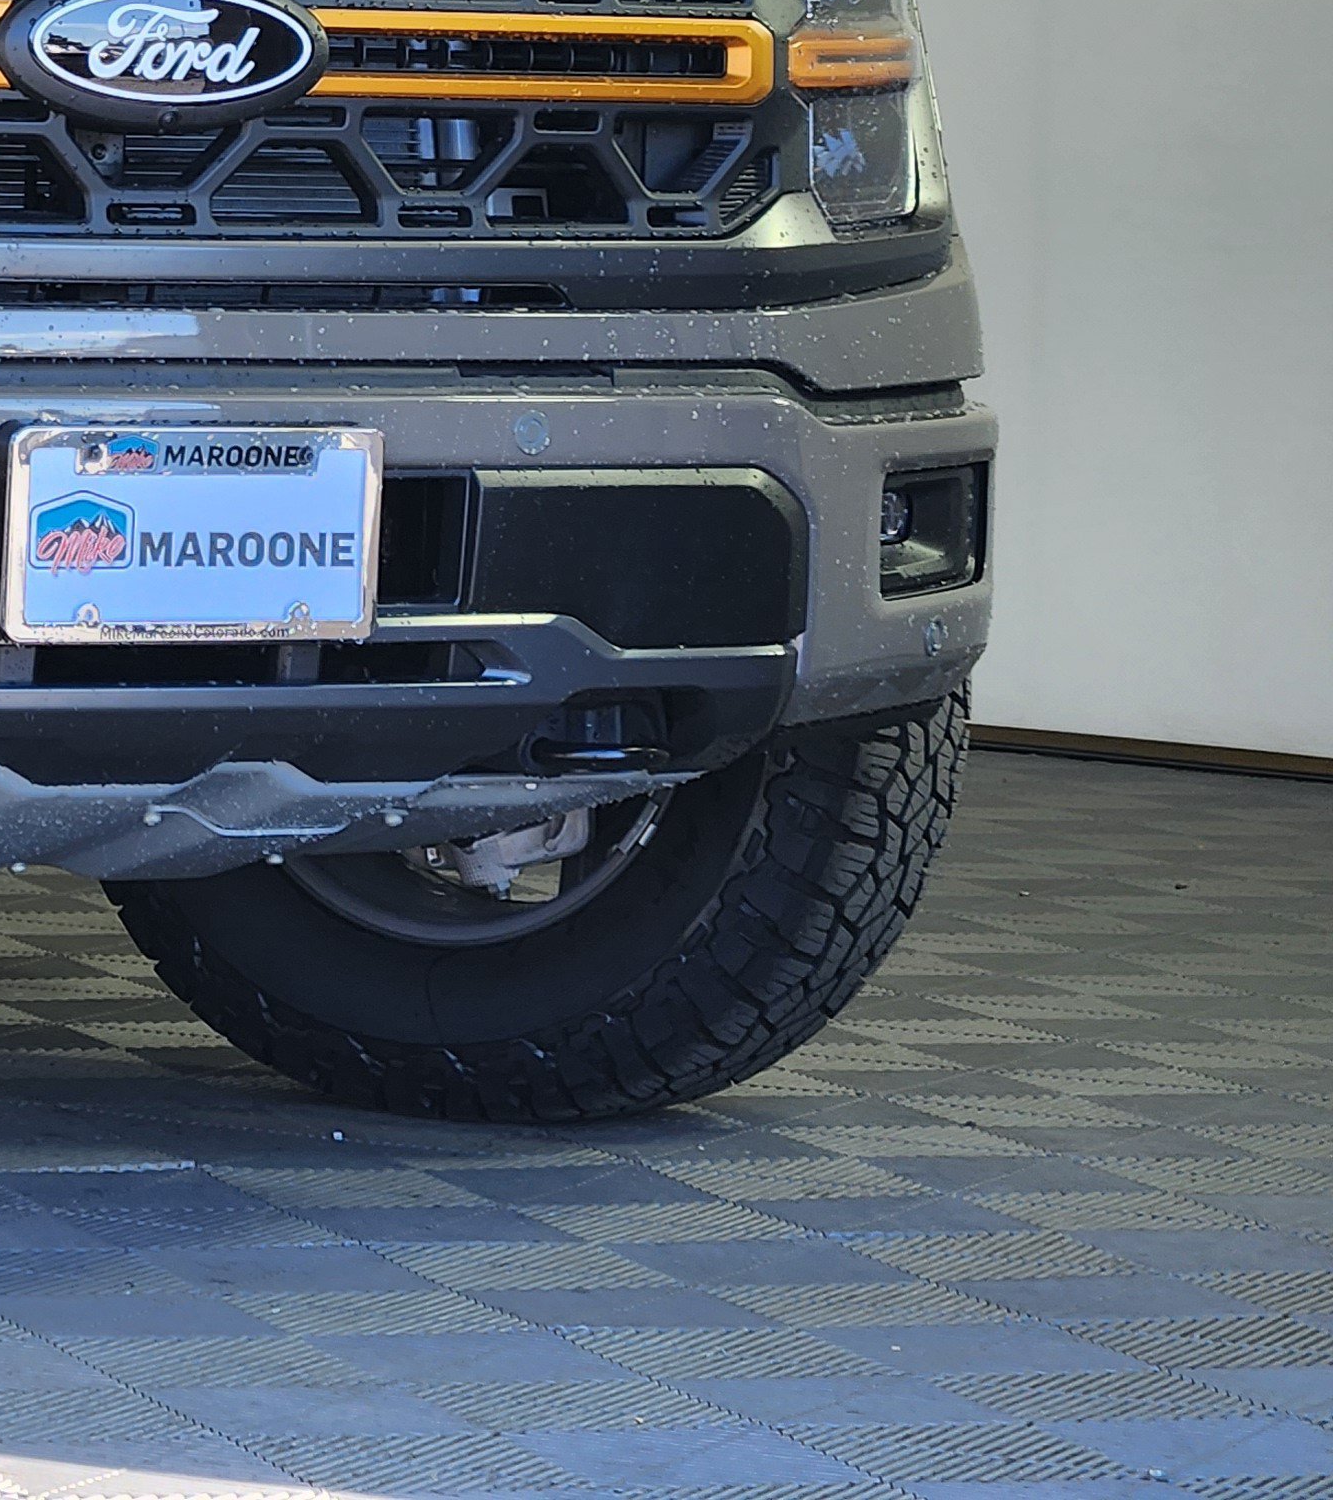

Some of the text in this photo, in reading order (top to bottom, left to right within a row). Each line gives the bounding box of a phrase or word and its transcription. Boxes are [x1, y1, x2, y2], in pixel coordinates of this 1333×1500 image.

[88, 3, 261, 83] Ford
[163, 445, 301, 467] MAROONE
[36, 526, 355, 577] Mike MAROONE
